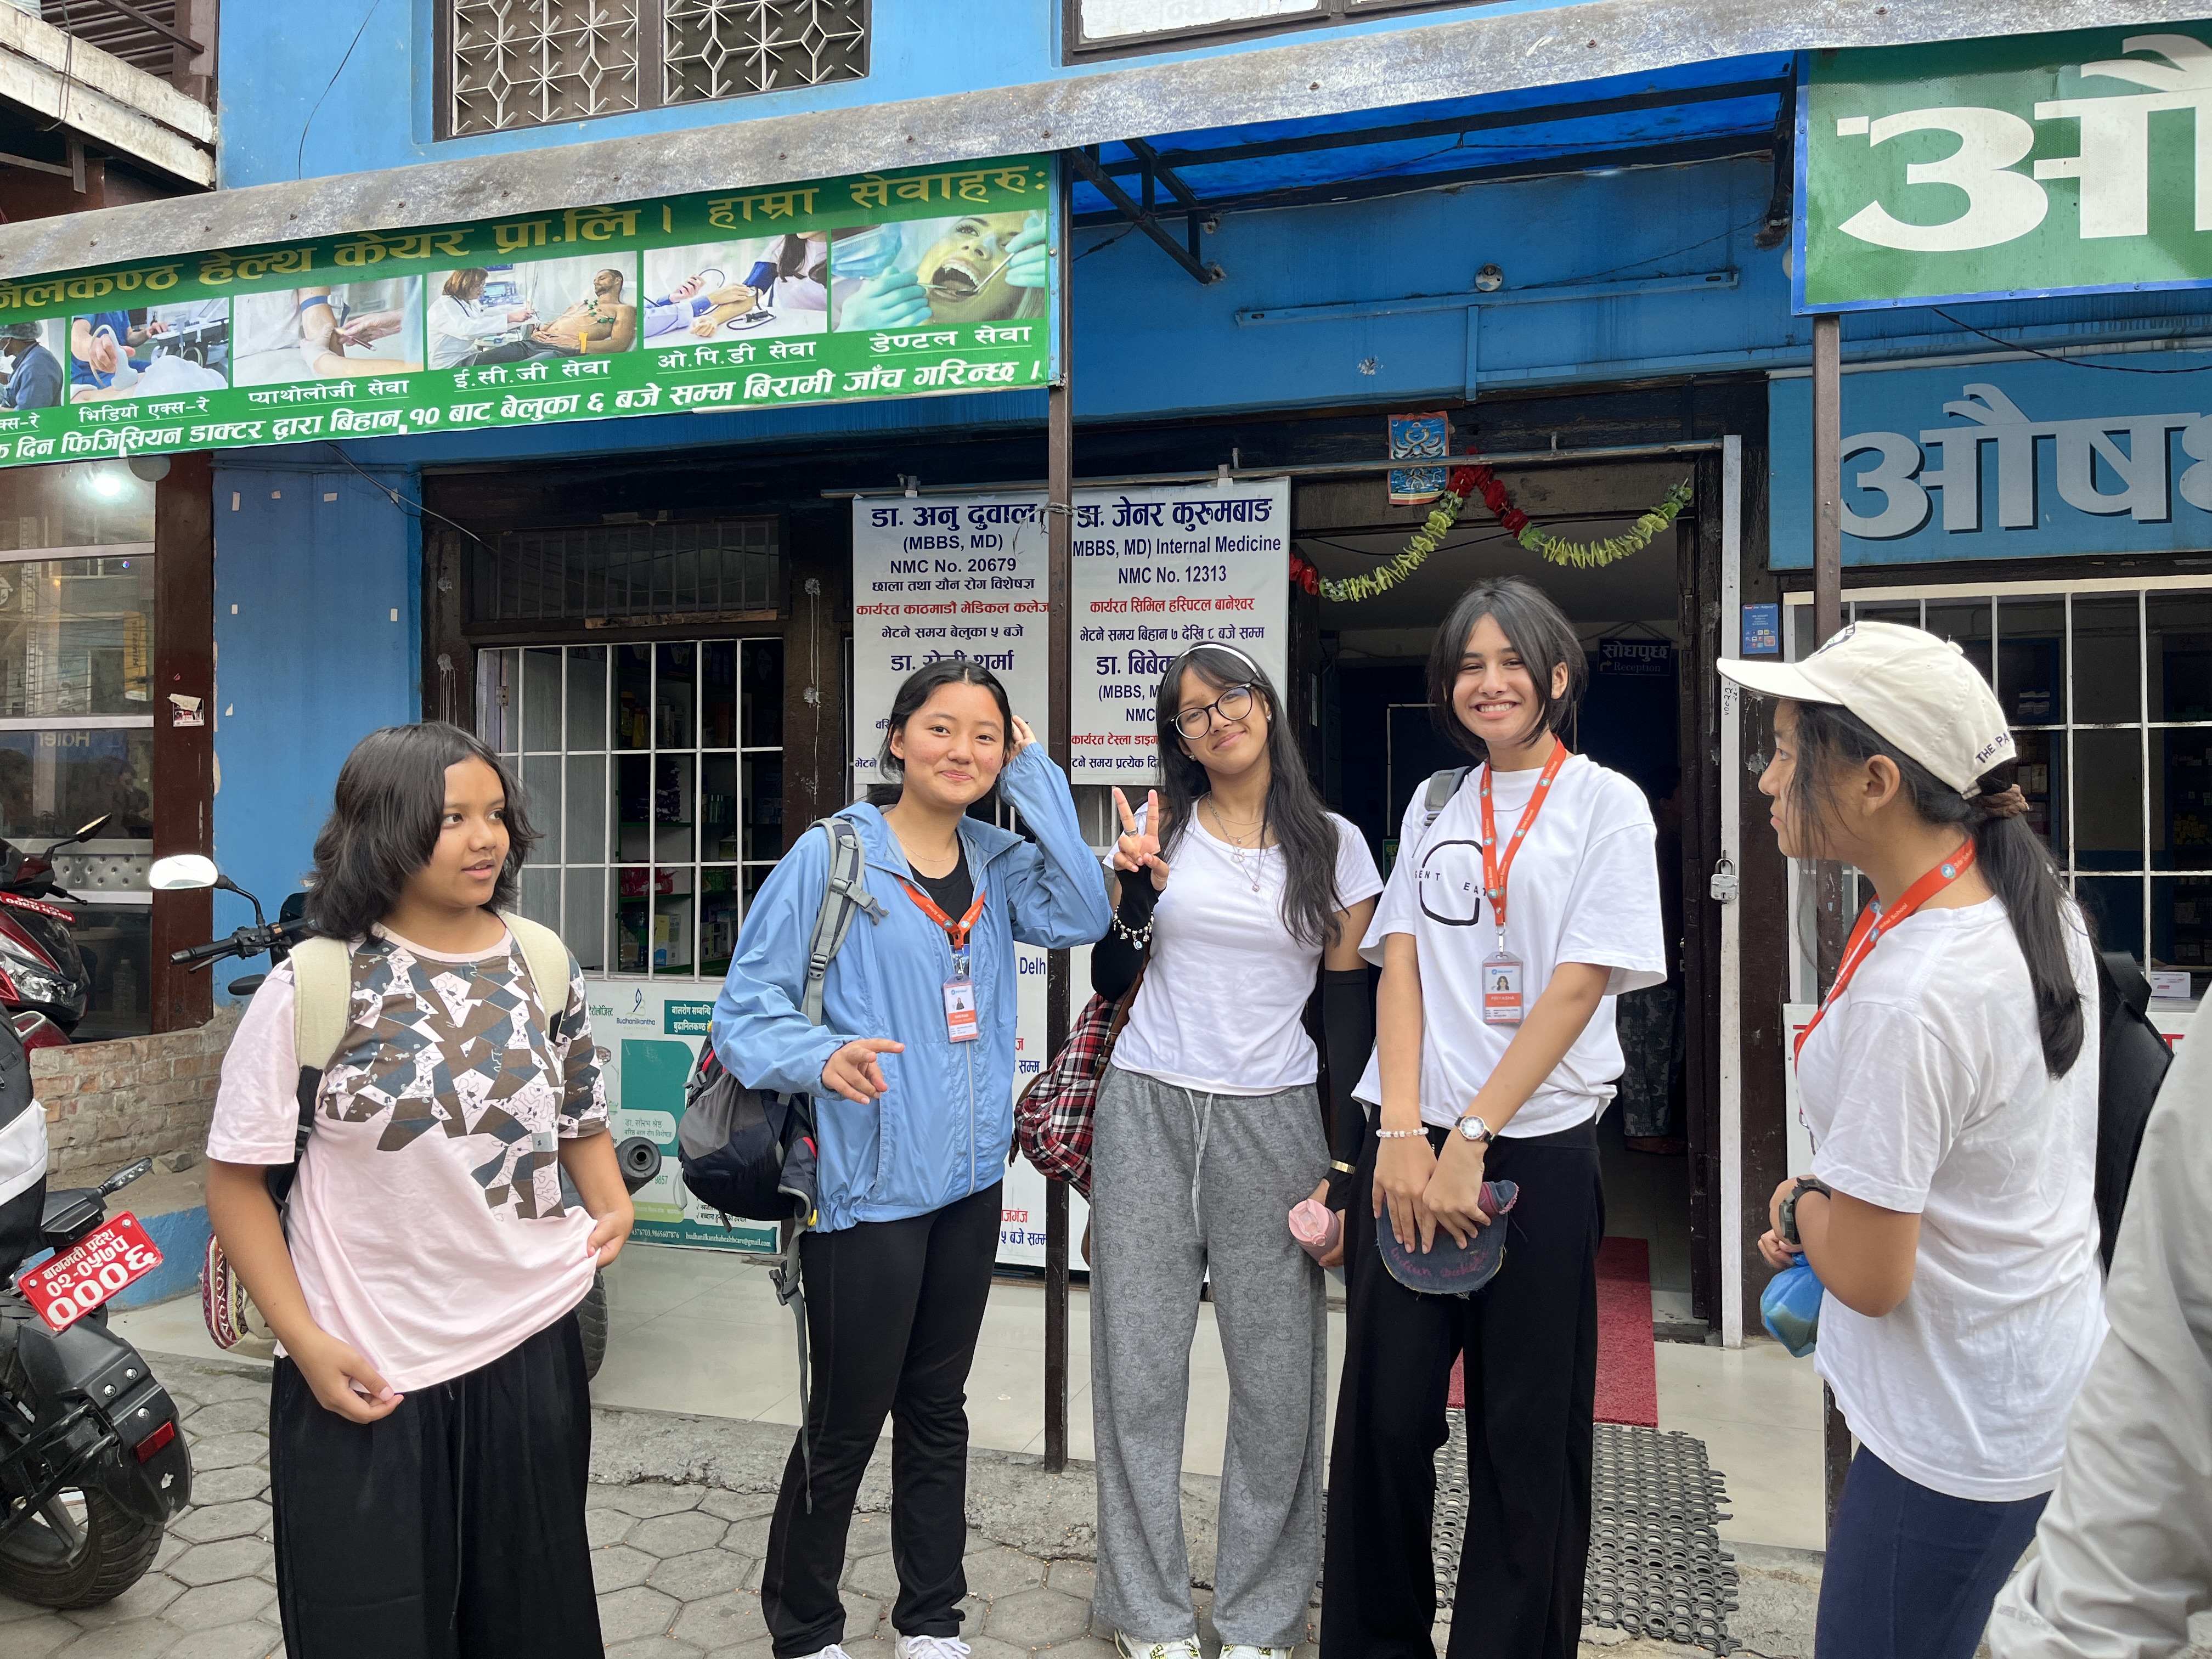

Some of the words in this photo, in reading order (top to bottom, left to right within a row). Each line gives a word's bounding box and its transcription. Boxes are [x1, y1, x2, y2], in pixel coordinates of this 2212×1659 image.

[199, 246, 317, 285] हेल्थ
[334, 228, 474, 266] केयर
[707, 187, 820, 229] हाम्रा
[869, 331, 958, 353] डेण्टल
[975, 325, 1032, 344] सेवा
[769, 341, 816, 359] सेवा
[454, 362, 549, 388] ई.सी.जी
[562, 359, 611, 377] सेवा
[249, 380, 356, 404] प्याथोलोजी
[368, 379, 409, 396] सेवा
[16, 436, 56, 458] दिन
[61, 426, 184, 454] फिजिसियन
[189, 420, 267, 443] डाक्टर
[272, 416, 324, 441] द्वारा
[330, 408, 403, 432] बिहान
[410, 407, 440, 426] १०
[450, 402, 494, 422] बाट
[500, 394, 581, 421] बेलुका
[588, 392, 604, 412] ६
[615, 382, 662, 408] बजे
[669, 381, 736, 406] सम्म
[743, 368, 836, 399] बिरामी
[843, 364, 906, 392] जाँच
[914, 358, 1020, 386] गरिन्छ
[78, 403, 139, 423] भिडियो
[149, 396, 210, 419] एक्स-रे
[0, 412, 40, 431] क्स-रे
[872, 507, 904, 527] डा.
[913, 505, 960, 531] अनु
[1077, 504, 1104, 528] डा.
[1112, 496, 1166, 527] जेनर
[903, 535, 964, 554] (MBBS,
[970, 534, 1003, 551] MD)
[1073, 539, 1119, 558] MBBS,
[1124, 538, 1152, 558] MD)
[1156, 536, 1210, 555] Internal
[1215, 534, 1281, 553] Medicine
[890, 560, 929, 574] NMC
[935, 559, 962, 573] No.
[967, 557, 1017, 572] 20679
[1118, 567, 1152, 584] NMC
[1156, 567, 1180, 583] No.
[1185, 565, 1227, 582] 12313
[872, 581, 904, 591] छाला
[907, 580, 931, 591] तथा
[935, 577, 960, 591] यौन
[964, 577, 986, 590] रोग
[856, 602, 900, 615] कार्यरत
[961, 600, 1009, 614] मेडिकल
[1090, 597, 1127, 613] कार्यरत
[1131, 596, 1166, 612] सिभिल
[1169, 595, 1212, 612] हस्पिटल
[1215, 594, 1255, 611] बानेश्वर
[882, 625, 911, 638] भेटने
[915, 627, 947, 638] समय
[950, 624, 987, 640] बेलुका
[990, 627, 998, 638] ५
[1003, 623, 1024, 637] बजे
[1080, 626, 1105, 641] भेटने
[1108, 629, 1135, 641] समय
[1138, 625, 1167, 641] बिहान
[1171, 627, 1178, 639] ७
[1182, 624, 1205, 641] देखि
[1207, 628, 1215, 639] ८
[1218, 623, 1236, 639] बजे
[1239, 626, 1265, 639] सम्म
[891, 654, 916, 672] डा.
[1096, 656, 1121, 675] डा.
[1614, 662, 1661, 674] Reception
[1098, 685, 1145, 702] (MBBS,
[1126, 708, 1155, 721] NMC
[1071, 732, 1104, 745] कार्यरत
[1108, 732, 1131, 745] टेस्ला
[1975, 743, 1996, 763] THE
[855, 757, 878, 768] भेटने
[1071, 755, 1086, 768] टने
[1089, 758, 1113, 768] समय
[1115, 755, 1144, 770] प्रत्येक
[1891, 902, 1908, 920] School
[1019, 957, 1046, 975] Delh
[672, 1004, 691, 1015] बालरोग
[616, 1017, 656, 1025] Budhanilkantha
[1019, 1060, 1040, 1074] सम्म
[654, 1175, 668, 1185] 9857
[1009, 1228, 1024, 1244] बजे
[42, 1246, 87, 1280] बागमती
[86, 1228, 115, 1252] प्रदेश
